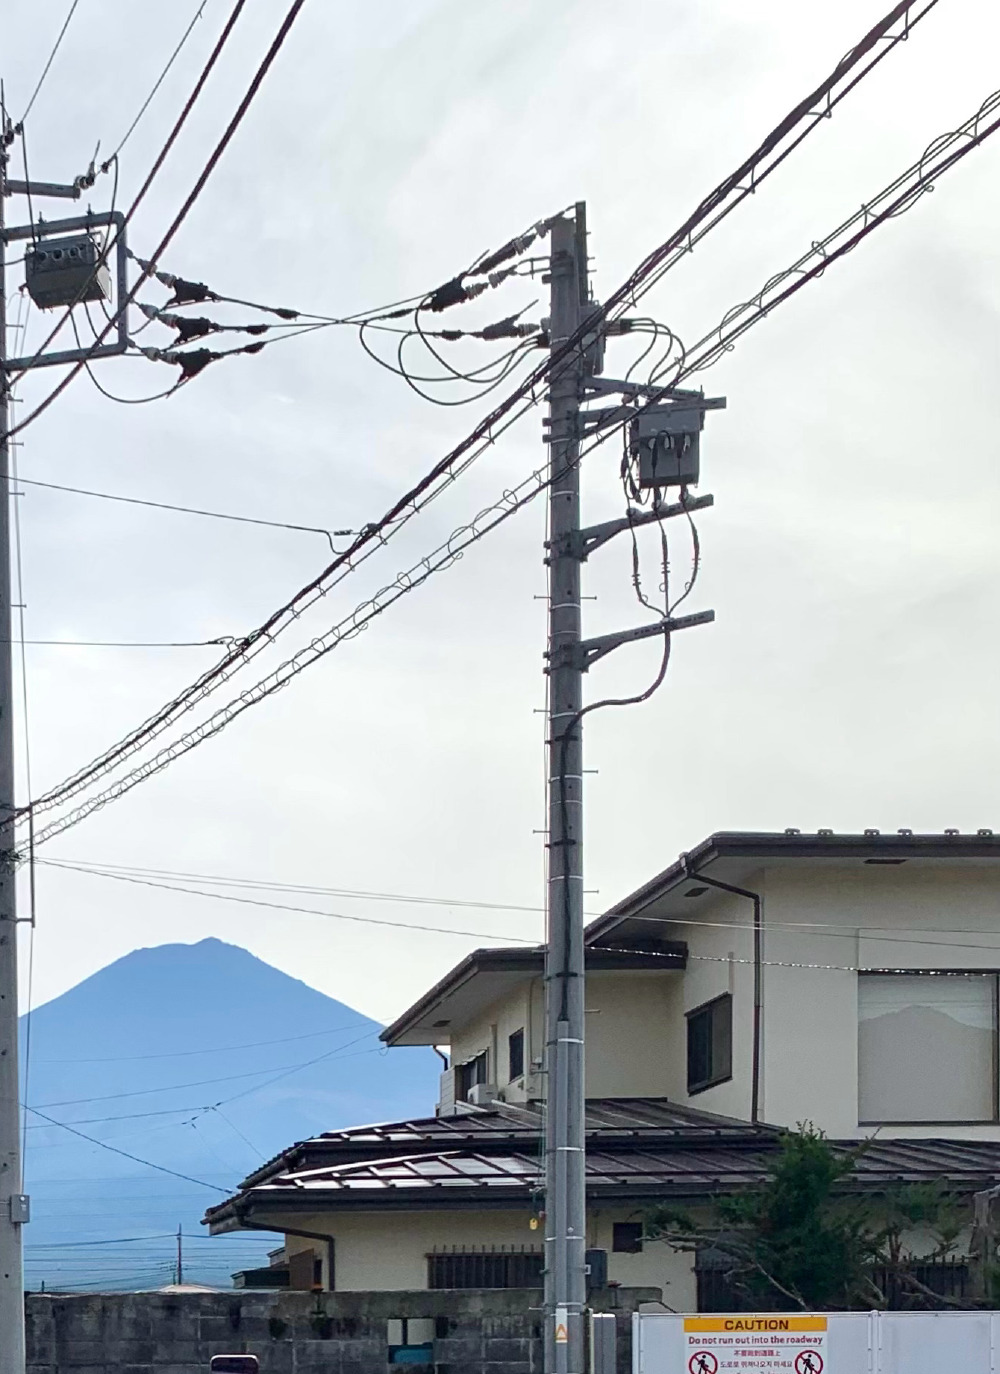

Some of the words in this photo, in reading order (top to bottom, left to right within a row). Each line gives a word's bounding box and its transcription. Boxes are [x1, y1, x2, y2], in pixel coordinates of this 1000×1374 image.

[724, 1319, 789, 1331] CAUTION
[688, 1336, 701, 1345] Do
[702, 1336, 717, 1345] not
[735, 1336, 750, 1344] out
[751, 1335, 769, 1344] into
[770, 1335, 785, 1344] the
[786, 1335, 823, 1345] roadway
